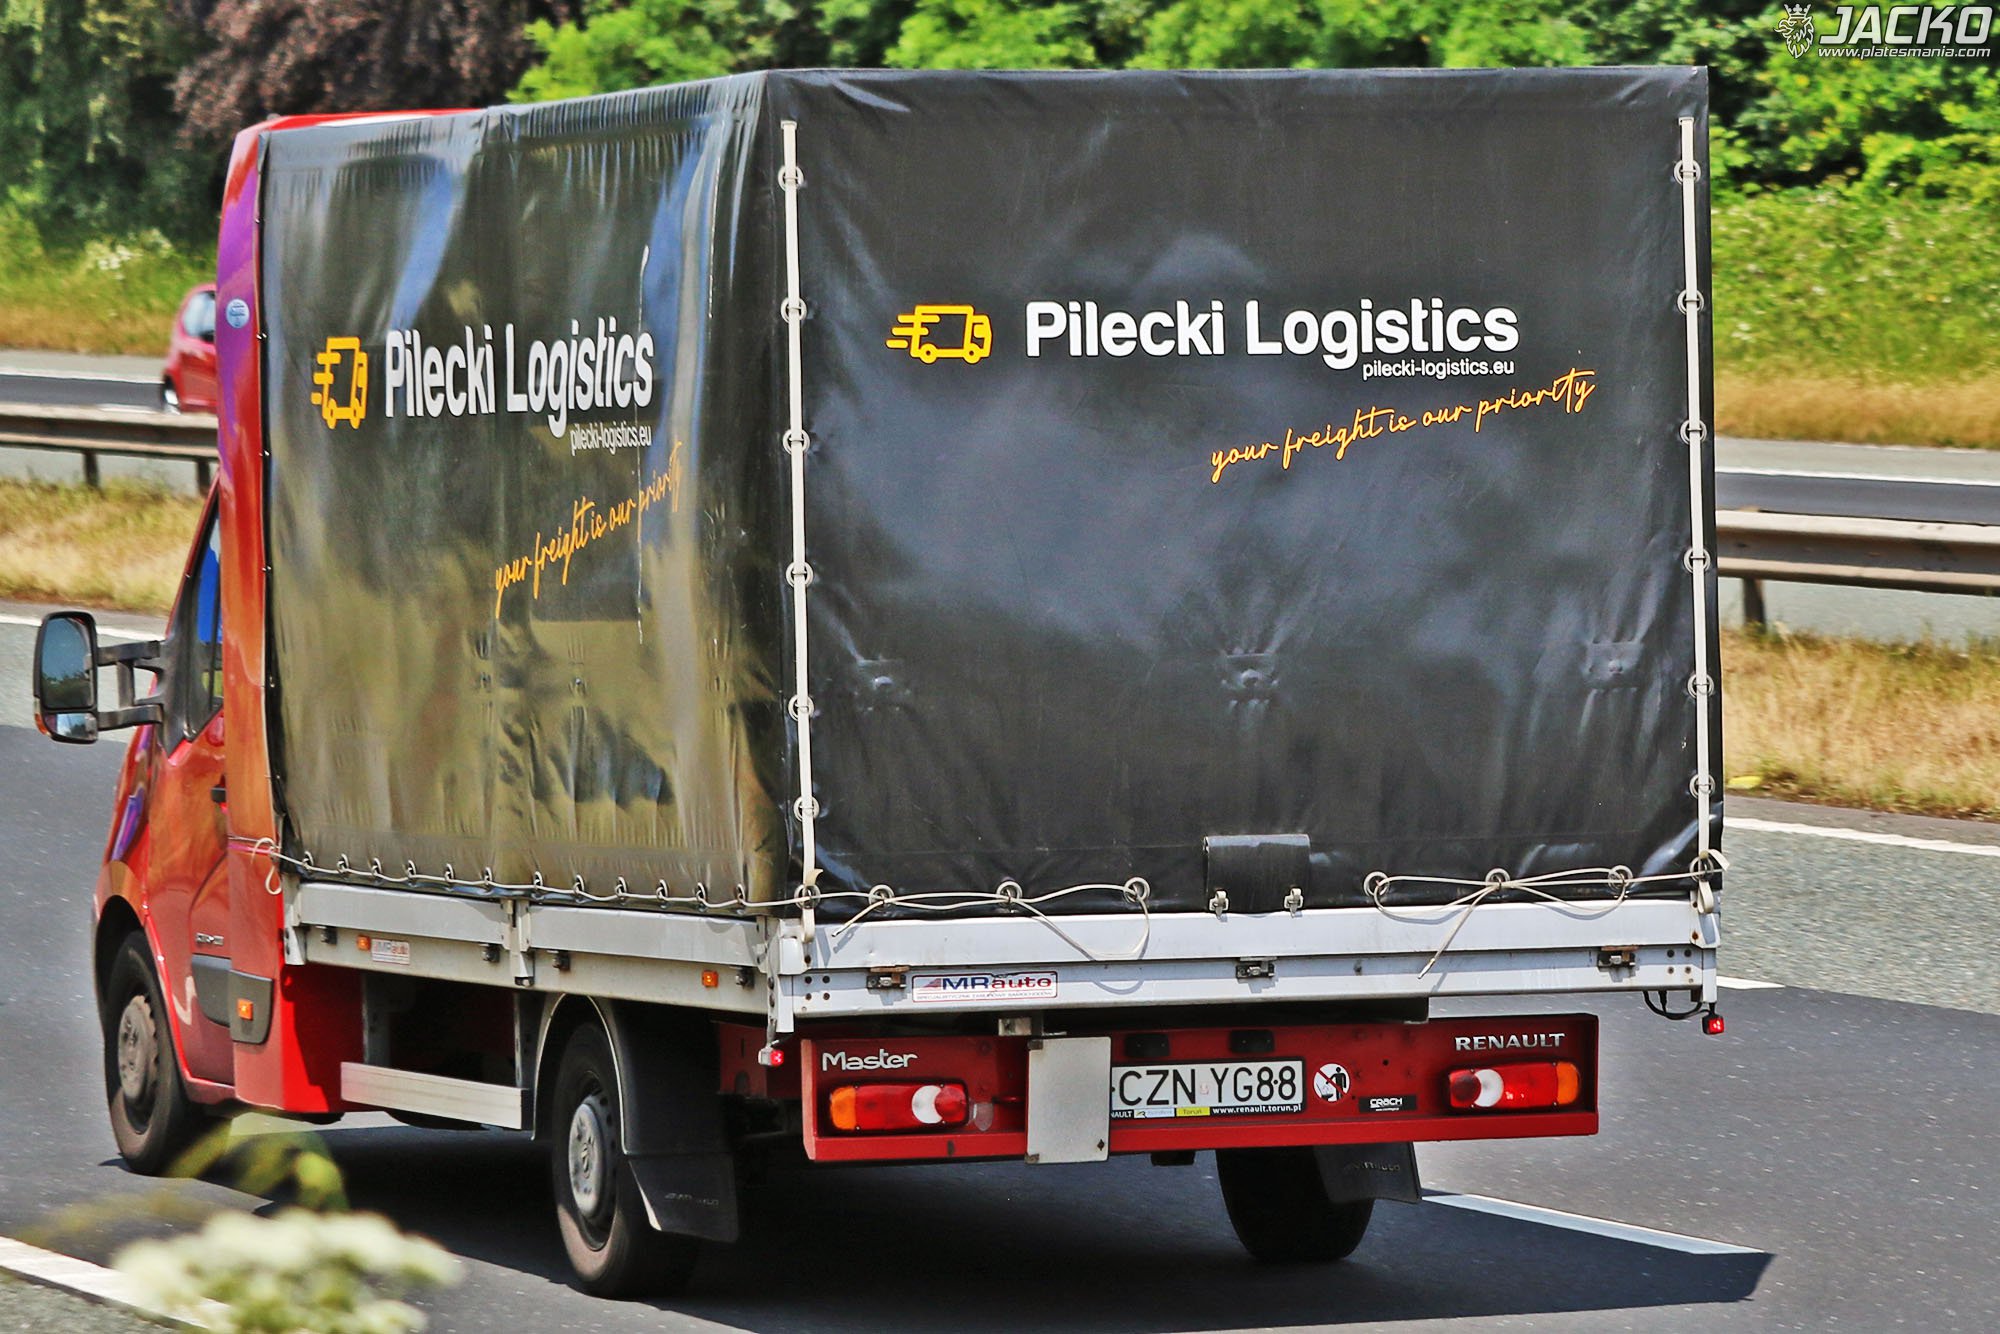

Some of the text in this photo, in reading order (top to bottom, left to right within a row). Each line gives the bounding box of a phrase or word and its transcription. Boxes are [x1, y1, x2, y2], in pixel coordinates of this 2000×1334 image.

[1026, 297, 1520, 370] Pilecki Logistics
[385, 316, 654, 438] Pilecki Logistics
[1362, 358, 1515, 381] pilecki-logistics.eu
[570, 420, 652, 457] pilecki-logistics.eu
[1211, 367, 1596, 483] your freight is our priority
[495, 556, 532, 619] your
[532, 496, 595, 600] freight
[591, 510, 607, 540] is
[609, 498, 636, 531] our
[822, 1048, 918, 1072] Master
[1455, 1033, 1566, 1051] RENAULT
[1119, 1065, 1296, 1106] CZN YG88
[1212, 1104, 1301, 1114] www.renault.torun.pl
